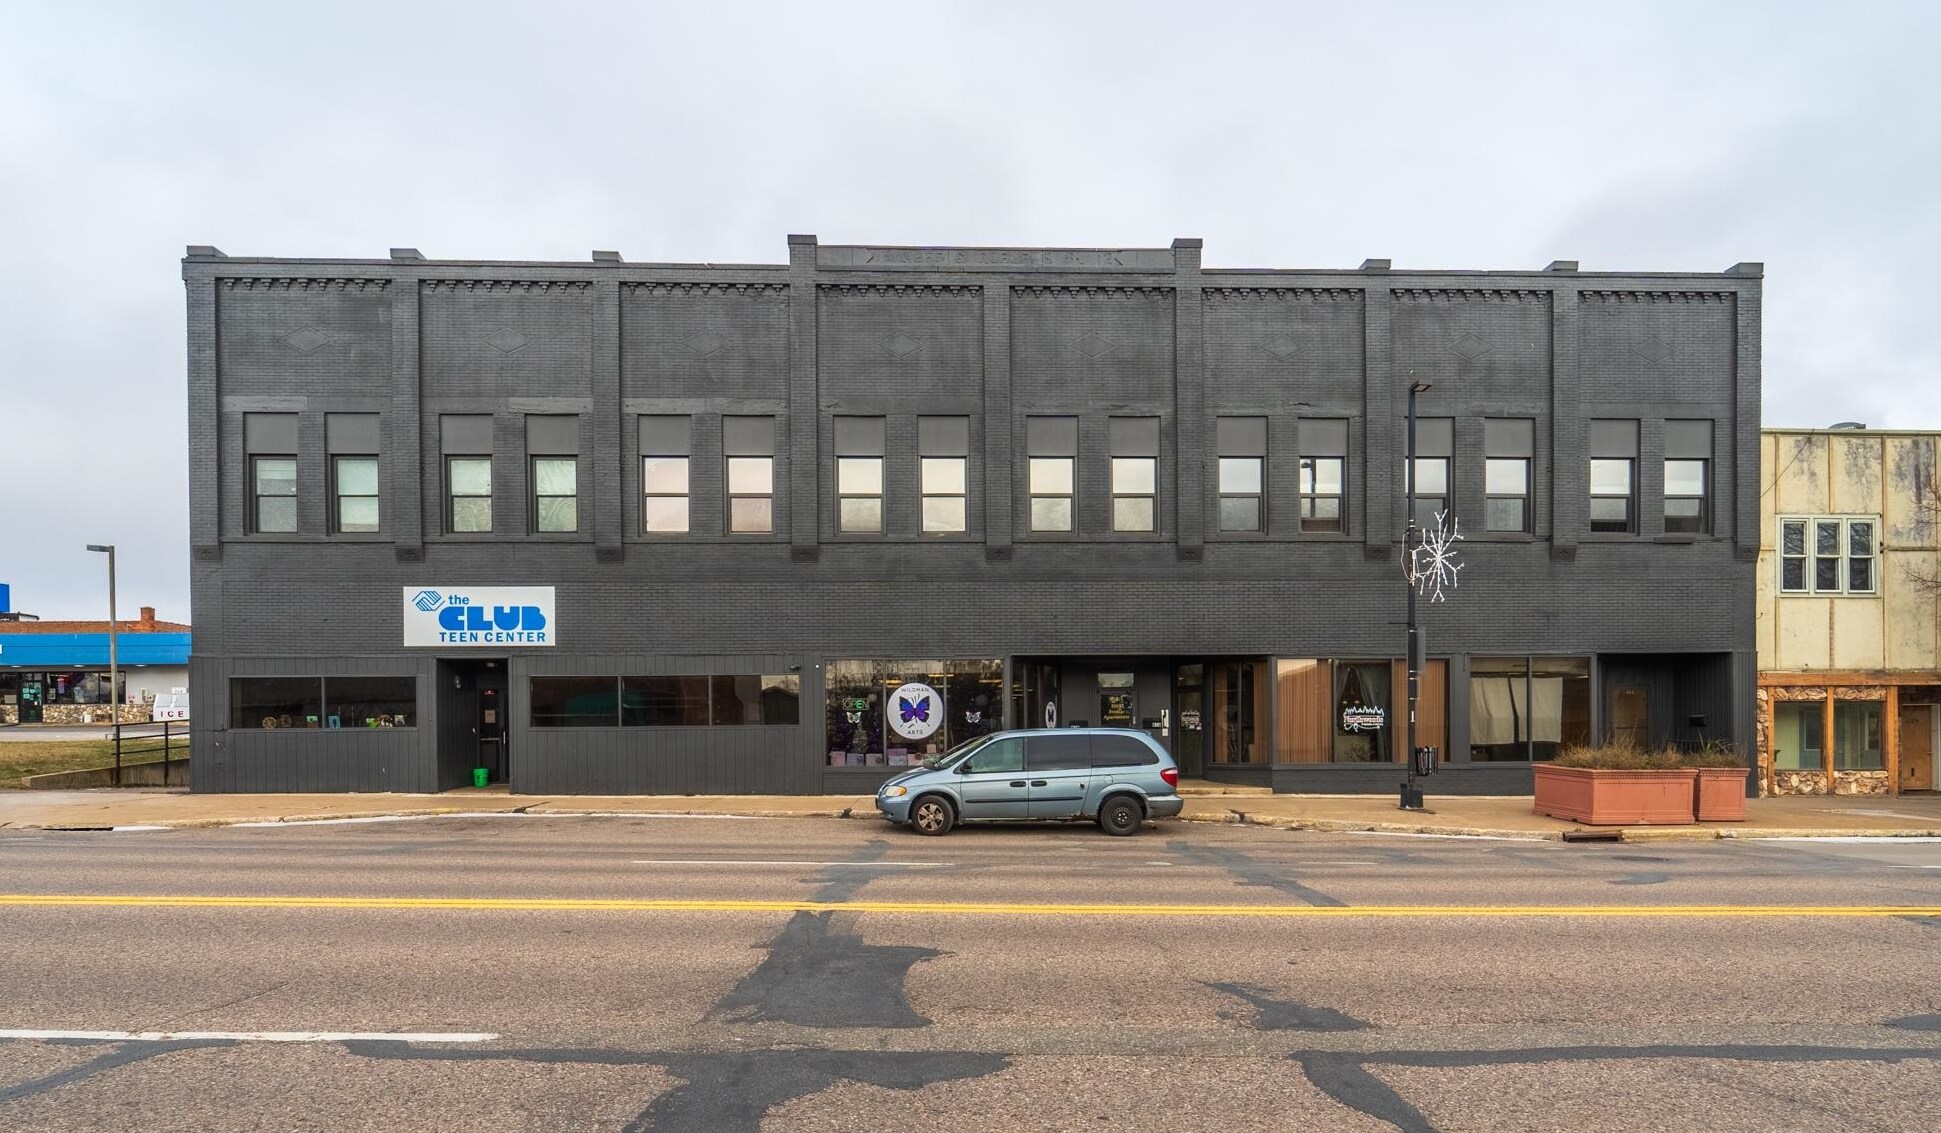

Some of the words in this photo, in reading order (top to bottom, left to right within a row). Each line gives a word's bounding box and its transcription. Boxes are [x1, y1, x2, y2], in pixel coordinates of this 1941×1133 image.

[448, 594, 470, 605] the
[438, 606, 547, 631] CLUB
[439, 632, 479, 642] TEEN
[484, 632, 546, 642] CENTER
[844, 700, 868, 709] OPEN
